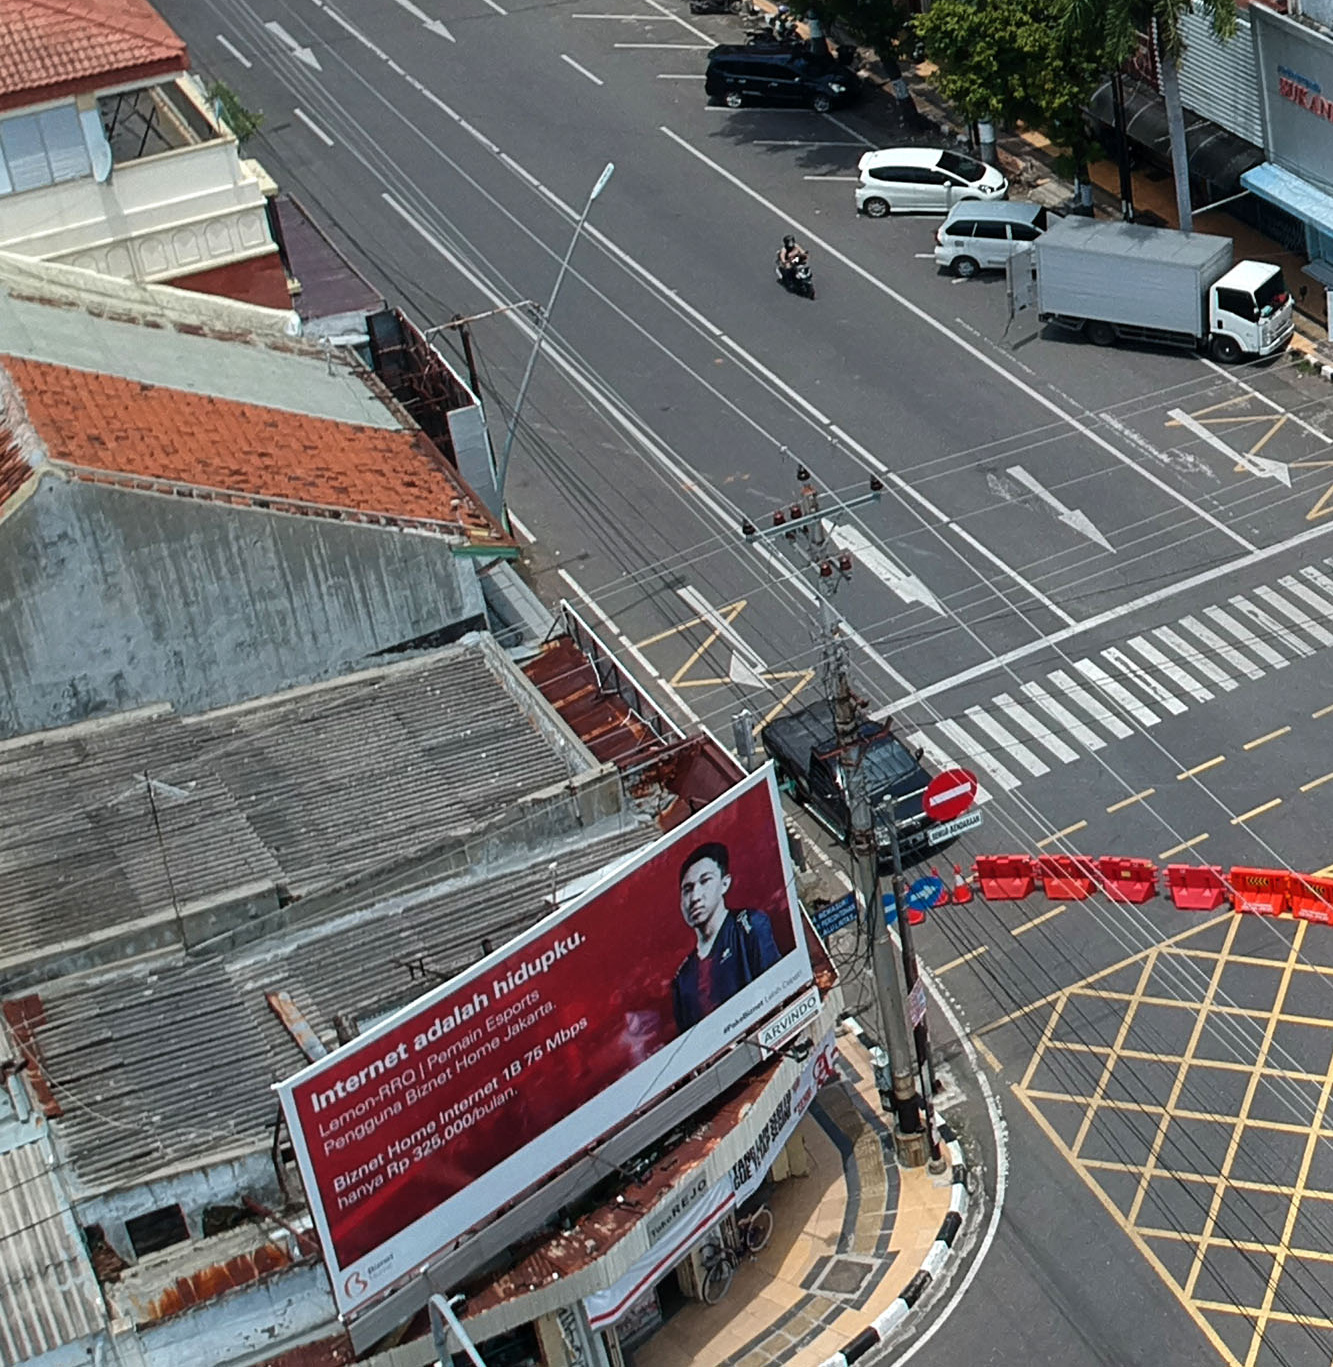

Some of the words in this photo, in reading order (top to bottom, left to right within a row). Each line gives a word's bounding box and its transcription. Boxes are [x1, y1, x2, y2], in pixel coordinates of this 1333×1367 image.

[310, 1043, 410, 1114] Internet
[414, 991, 489, 1053] adalah
[493, 931, 587, 1000] hidupku.
[318, 1067, 417, 1138] Lemon-RRQ
[427, 1029, 483, 1072] Pemain
[485, 989, 541, 1033] Esports
[323, 1102, 403, 1157] Pengguna
[406, 1067, 453, 1107] Biznet
[455, 1038, 500, 1075] Home
[503, 1001, 557, 1042] Jakarta.
[764, 996, 817, 1044] ARVINDO
[333, 1152, 384, 1194] Biznet
[387, 1120, 437, 1160] Home
[439, 1077, 500, 1126] Internet
[546, 1018, 588, 1055] Mbps
[337, 1176, 384, 1211] hanya
[387, 1158, 410, 1181] Rp
[412, 1089, 519, 1161] 325,000/bulan.
[672, 1178, 708, 1219] REJO
